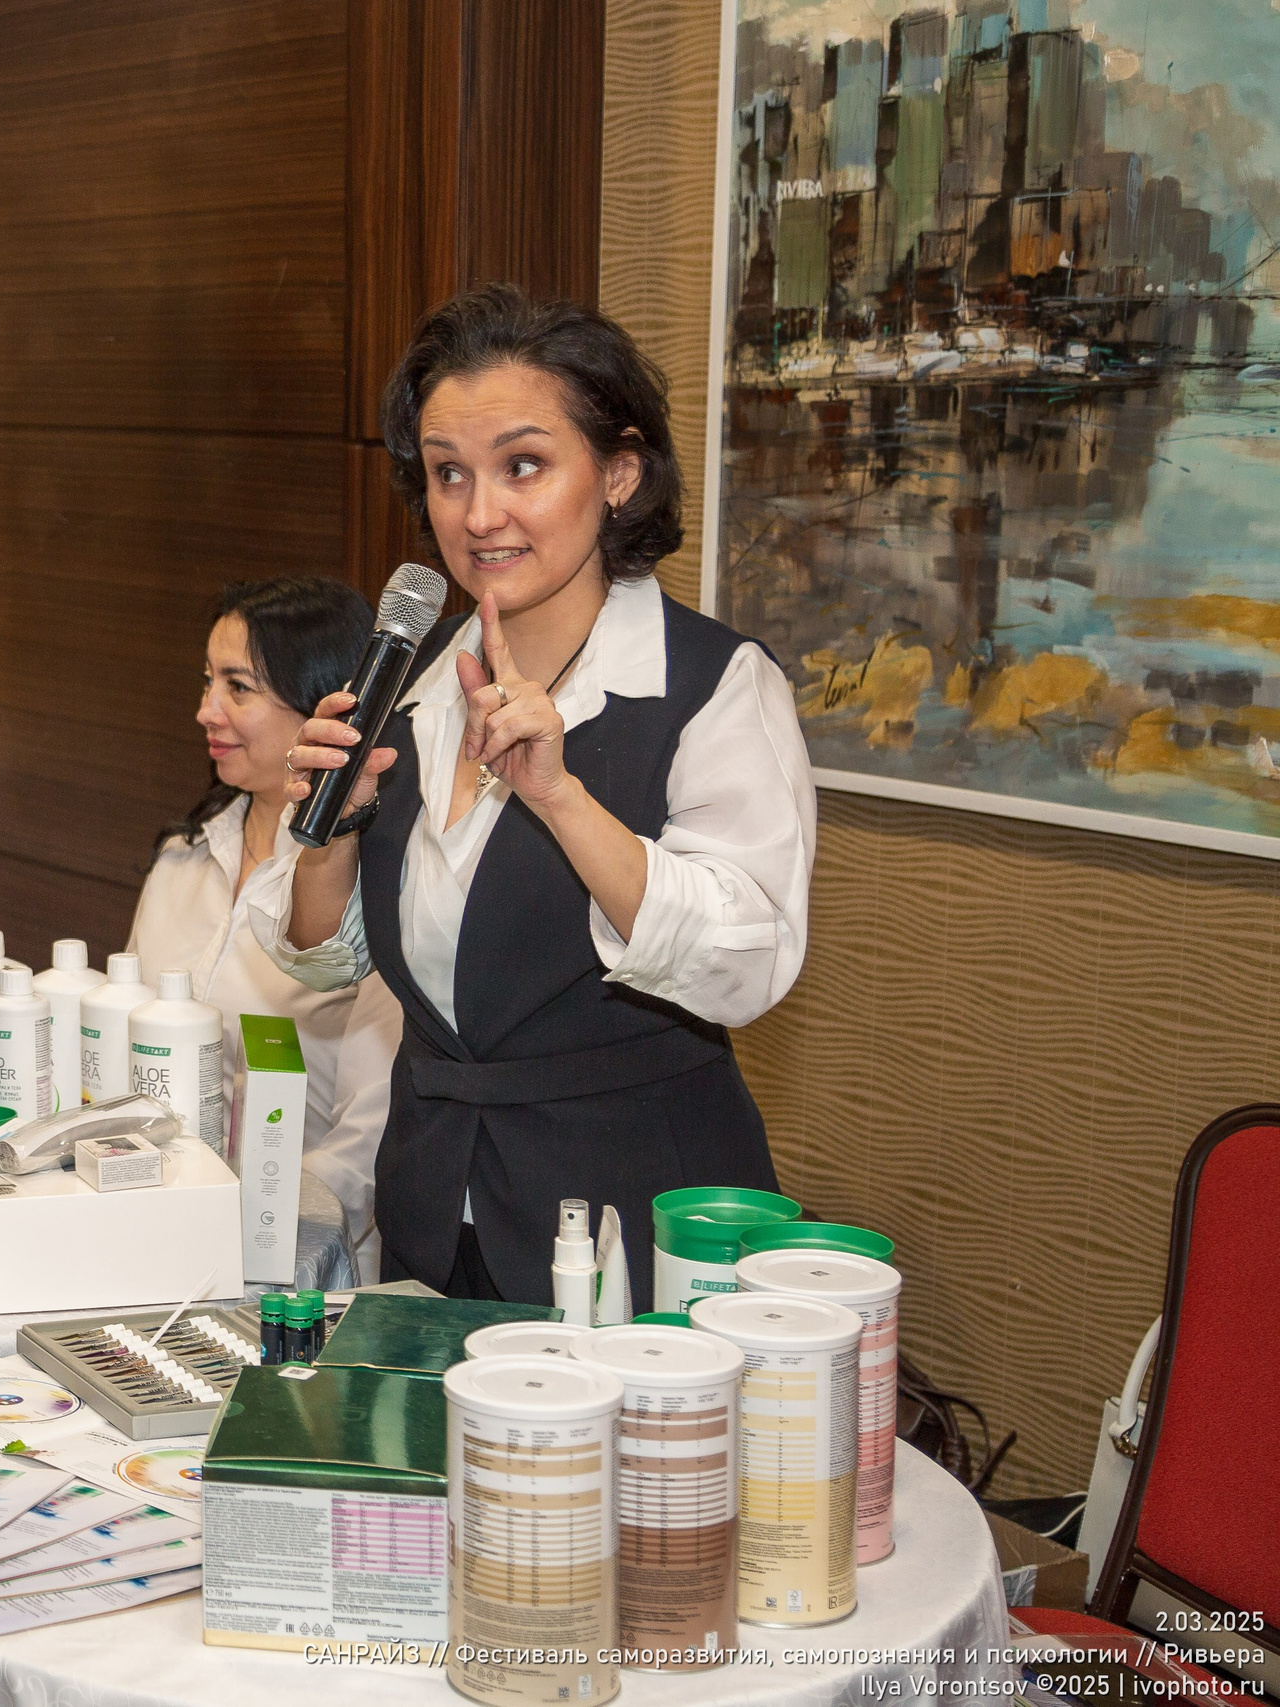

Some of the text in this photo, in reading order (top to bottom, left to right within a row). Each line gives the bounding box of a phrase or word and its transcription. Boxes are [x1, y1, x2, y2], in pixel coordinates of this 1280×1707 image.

[138, 1045, 169, 1055] LIFETAKT
[132, 1064, 171, 1084] ALOE
[132, 1079, 171, 1099] VERA
